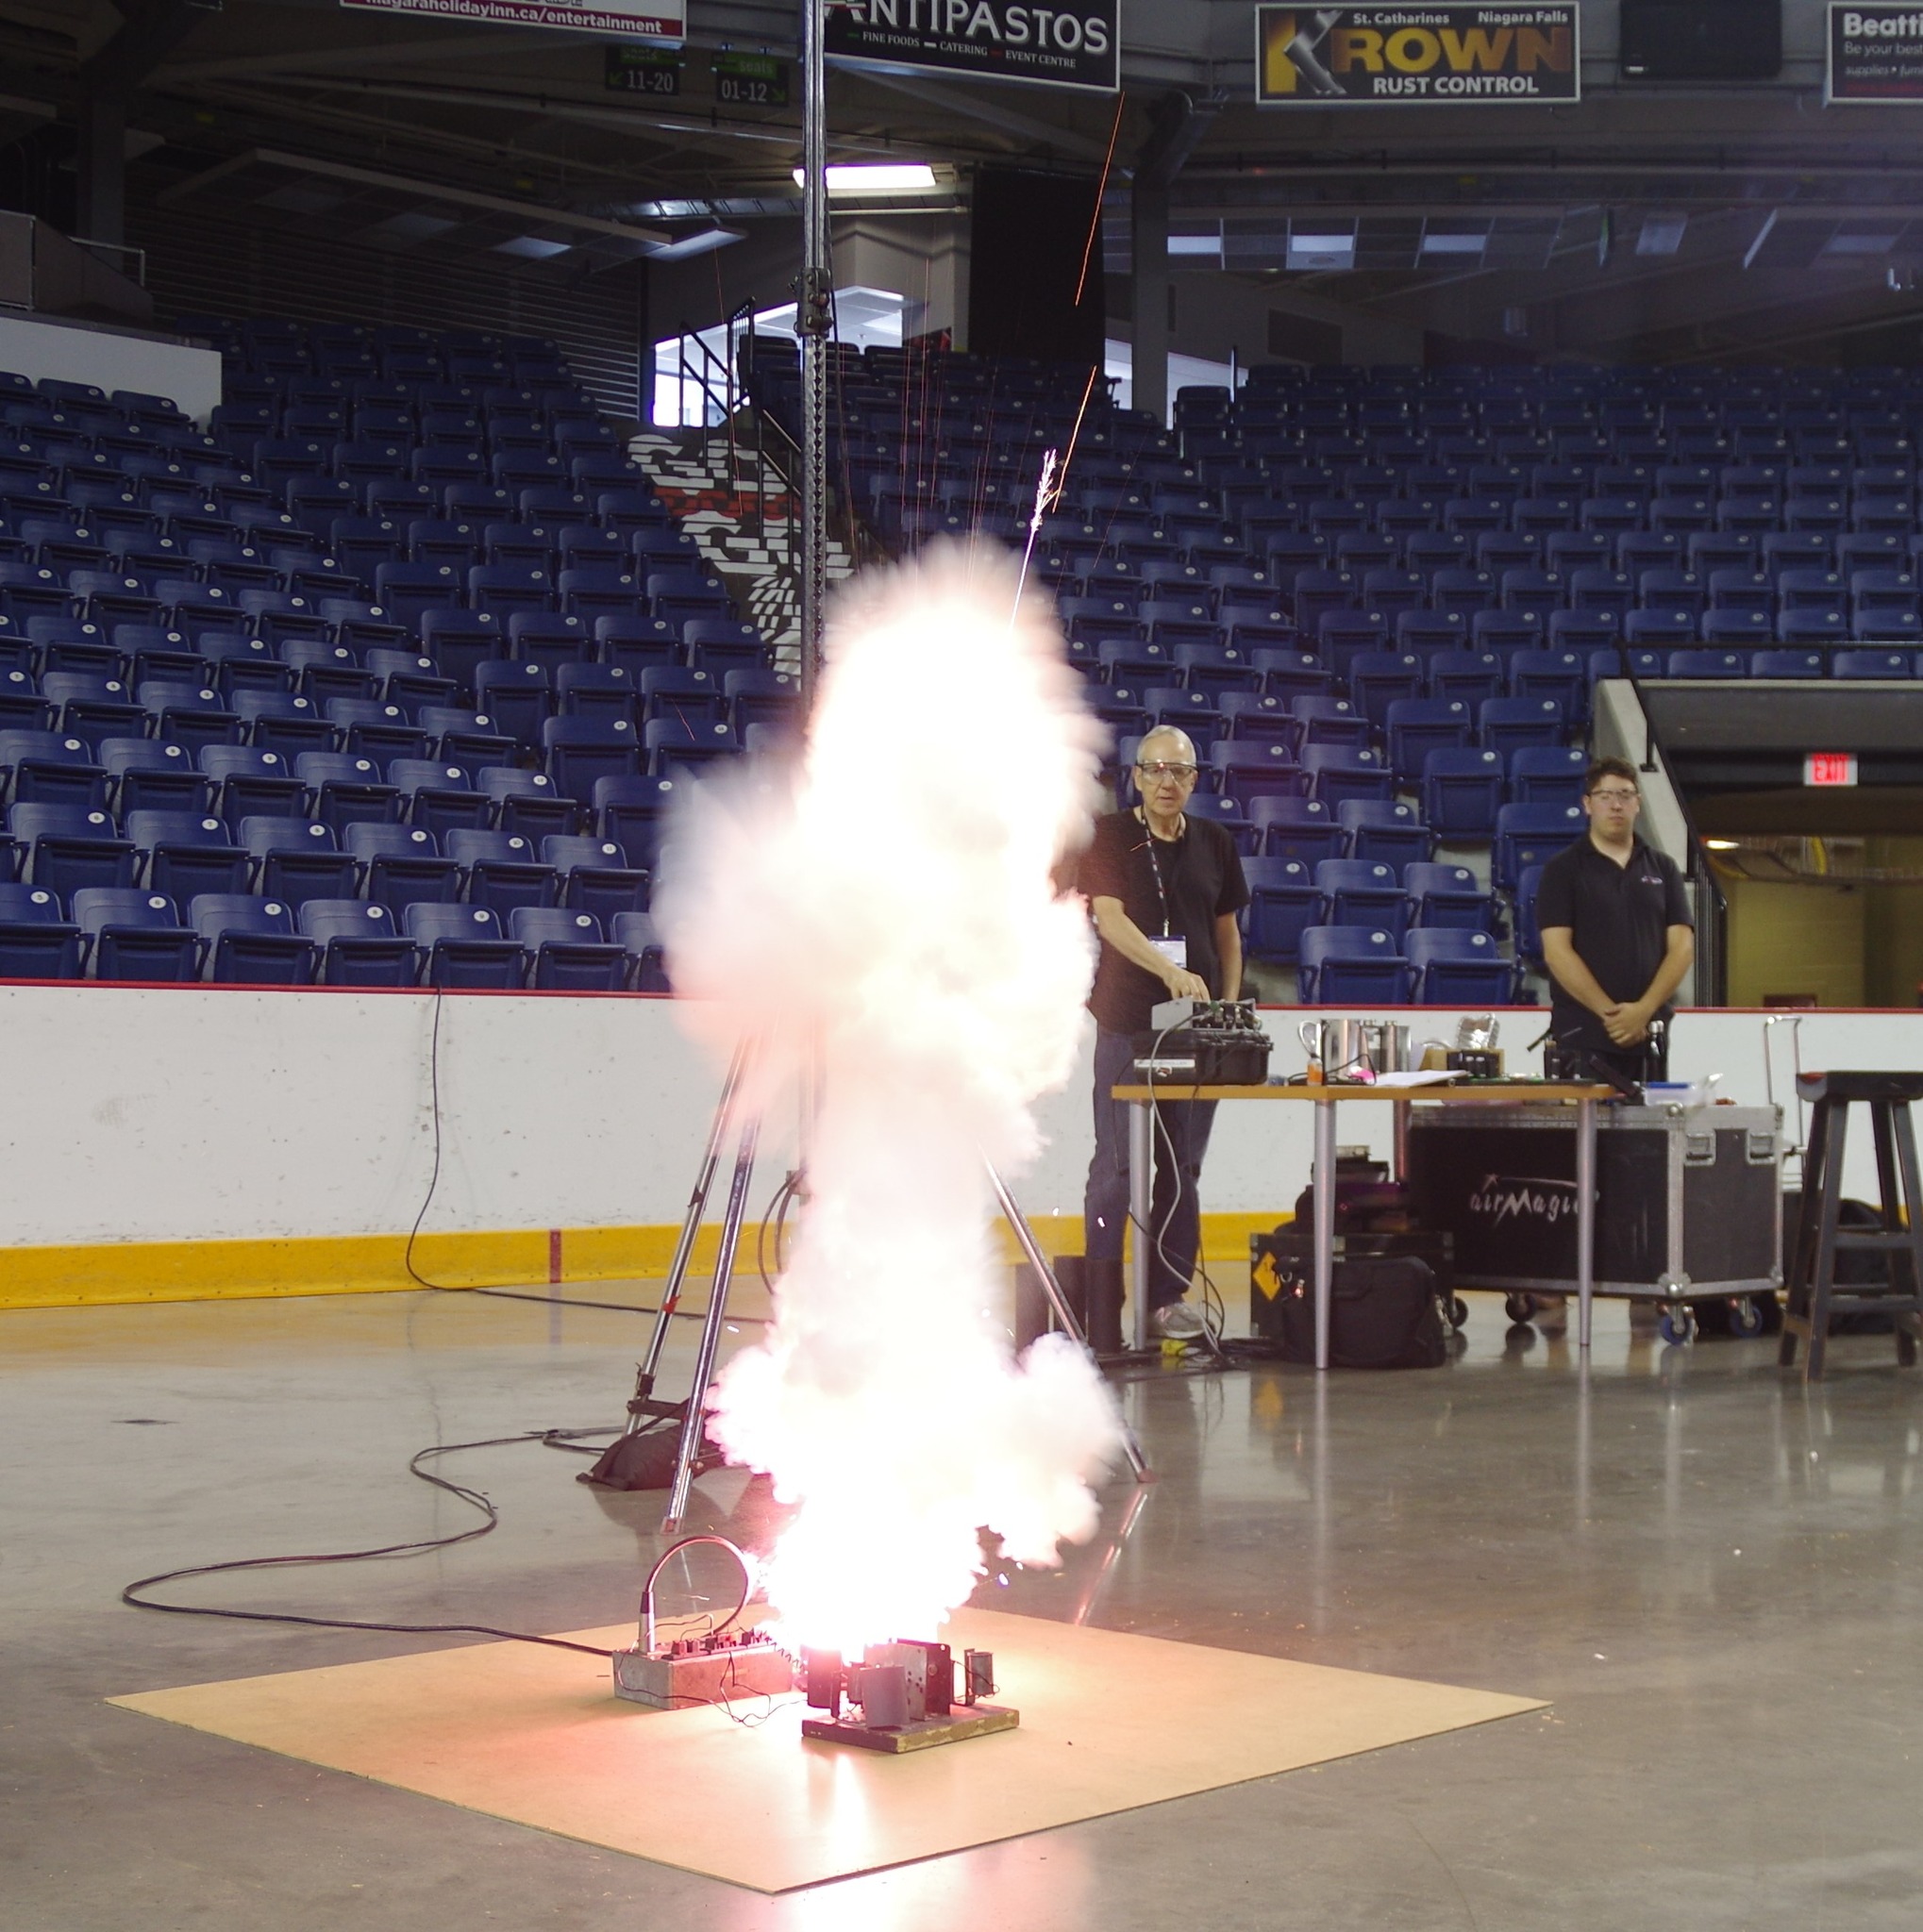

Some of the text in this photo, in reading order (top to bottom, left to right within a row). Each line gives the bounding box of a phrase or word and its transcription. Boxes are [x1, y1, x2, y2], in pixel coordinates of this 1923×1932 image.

[1353, 12, 1449, 25] St. Catharines
[1478, 11, 1568, 25] Niagara Falls
[862, 31, 920, 47] FINE FOODS
[940, 41, 988, 57] CATERING
[1005, 50, 1077, 69] EVENT CENTRE
[627, 69, 674, 92] 11-20
[1373, 76, 1539, 93] RUST CONTROL
[721, 79, 767, 102] 01-12
[1812, 754, 1848, 782] EXIT
